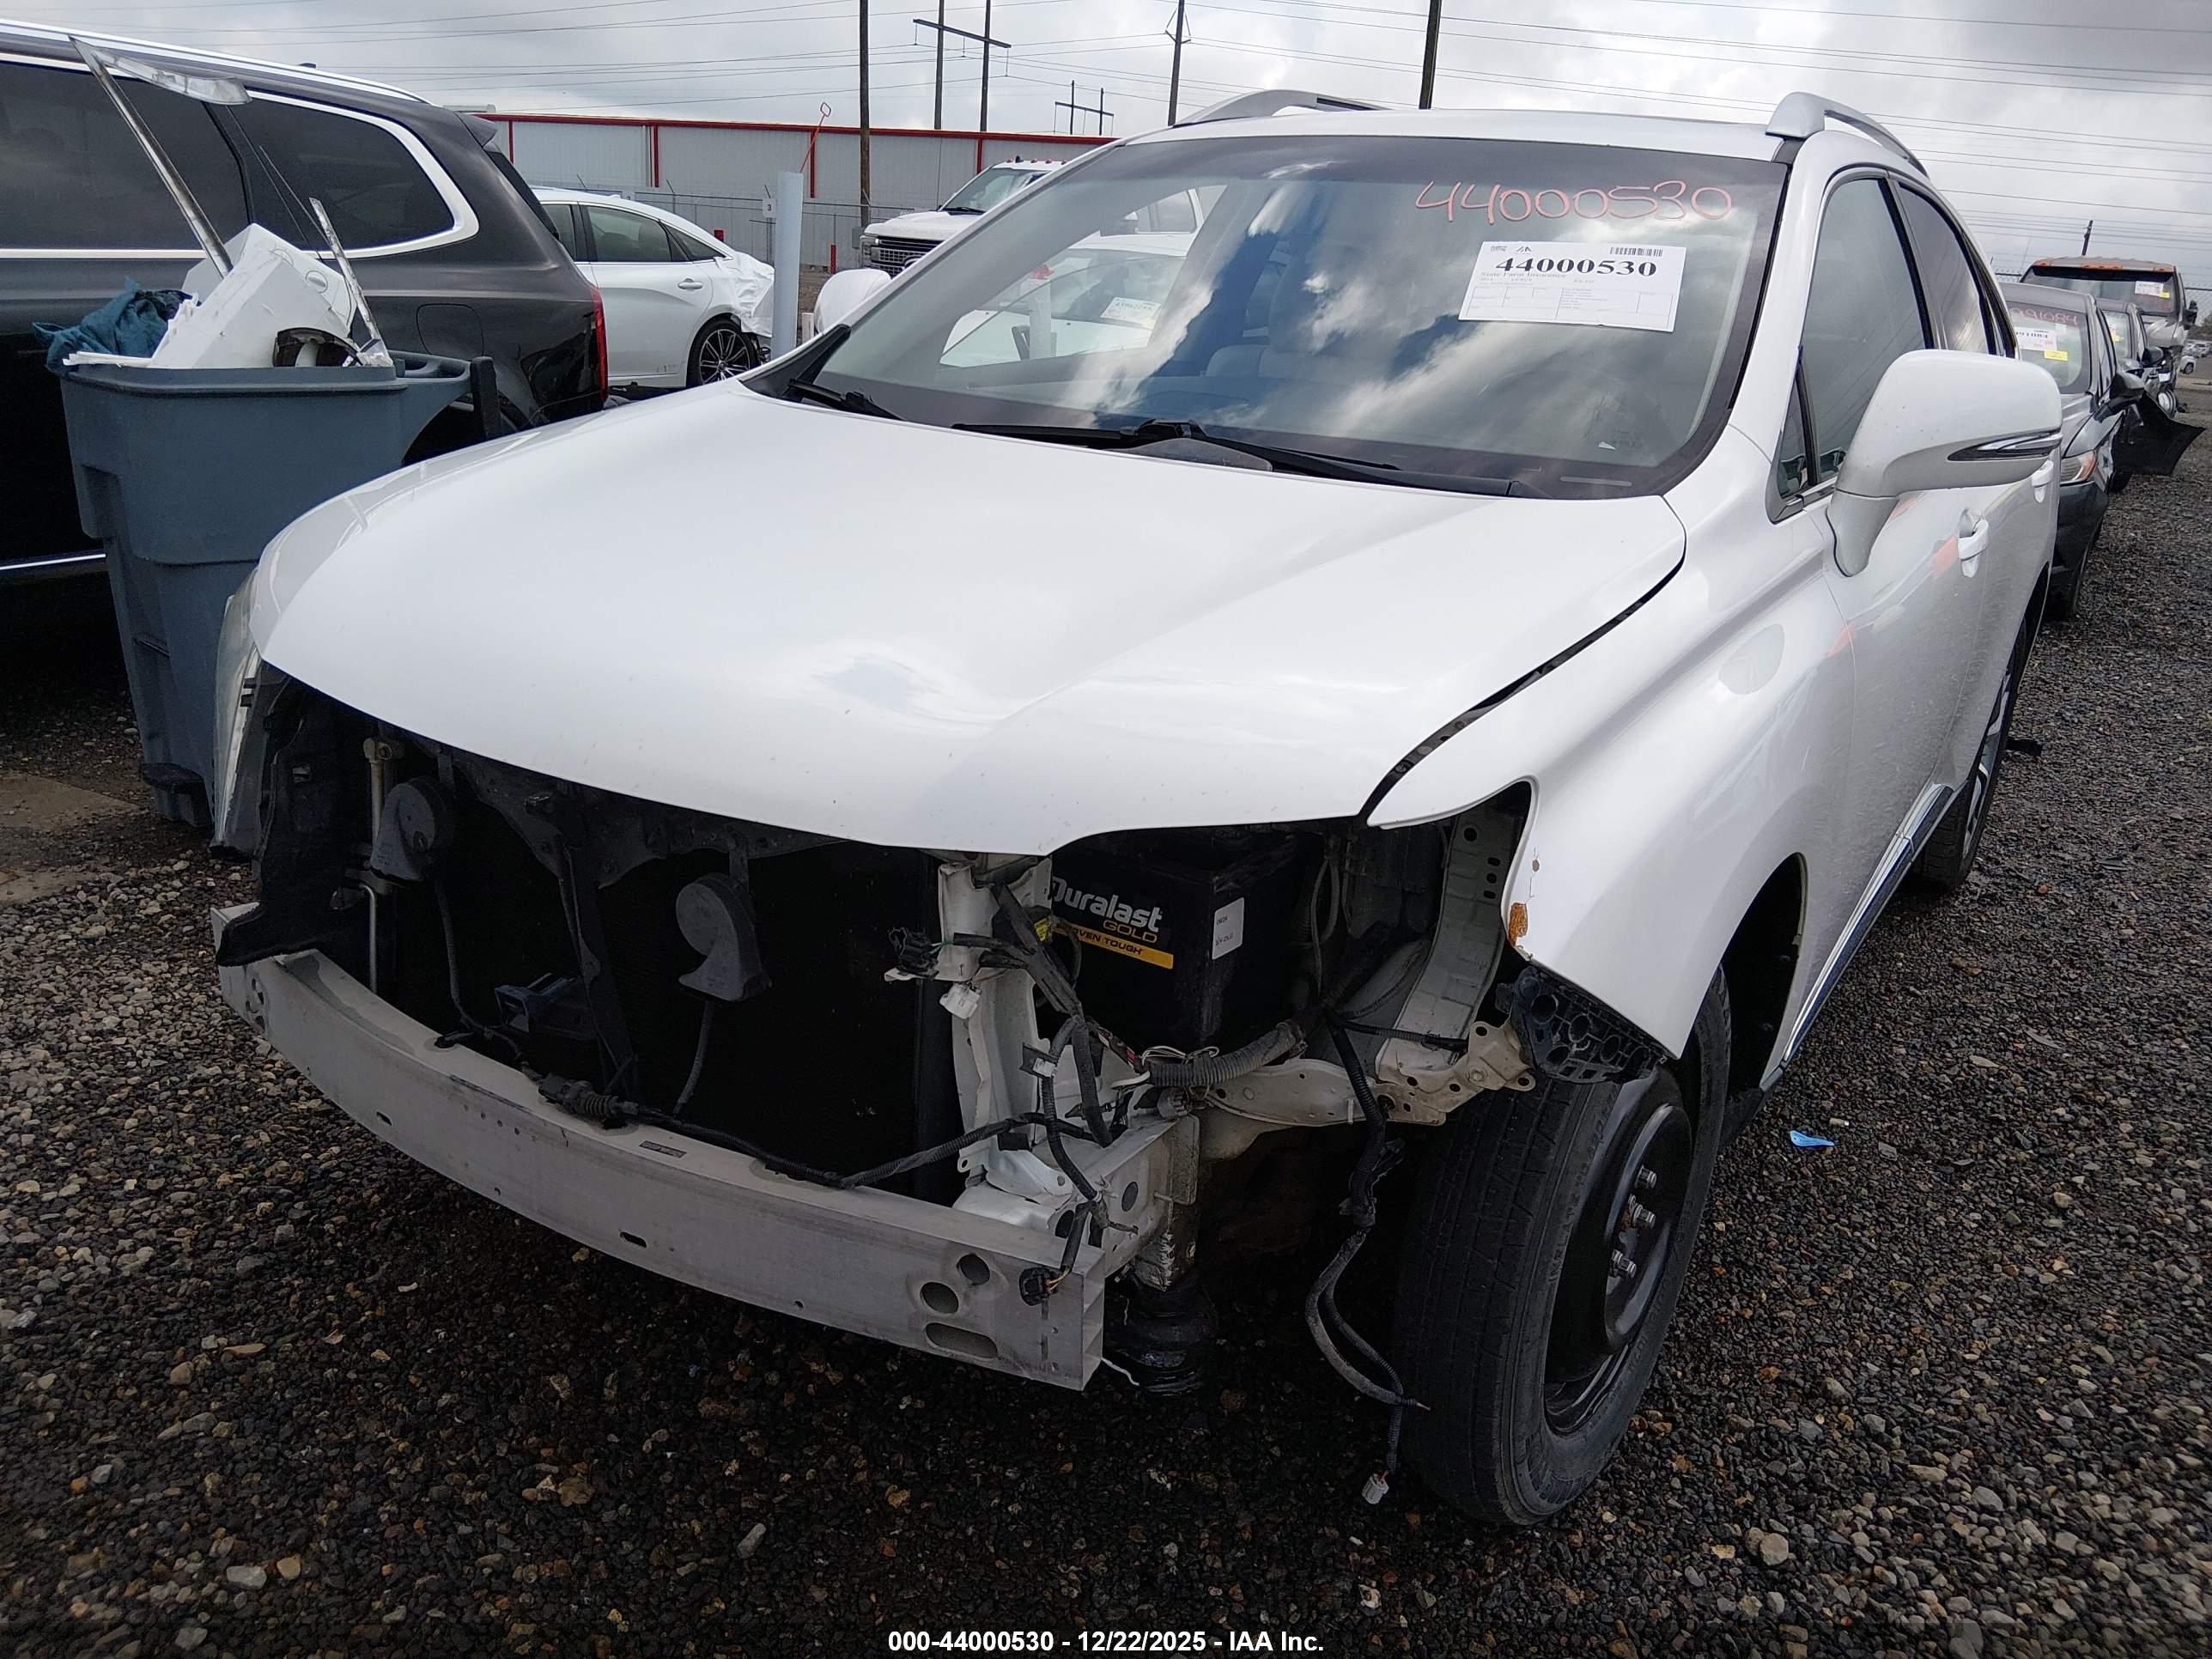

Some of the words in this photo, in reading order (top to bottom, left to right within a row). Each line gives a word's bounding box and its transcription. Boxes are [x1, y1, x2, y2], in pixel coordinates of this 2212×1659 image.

[1414, 180, 1733, 225] 44000530
[1495, 256, 1658, 277] 44000530
[1052, 876, 1163, 933] Duralast
[1103, 920, 1158, 943] GOLD
[1104, 937, 1143, 955] TOUGH
